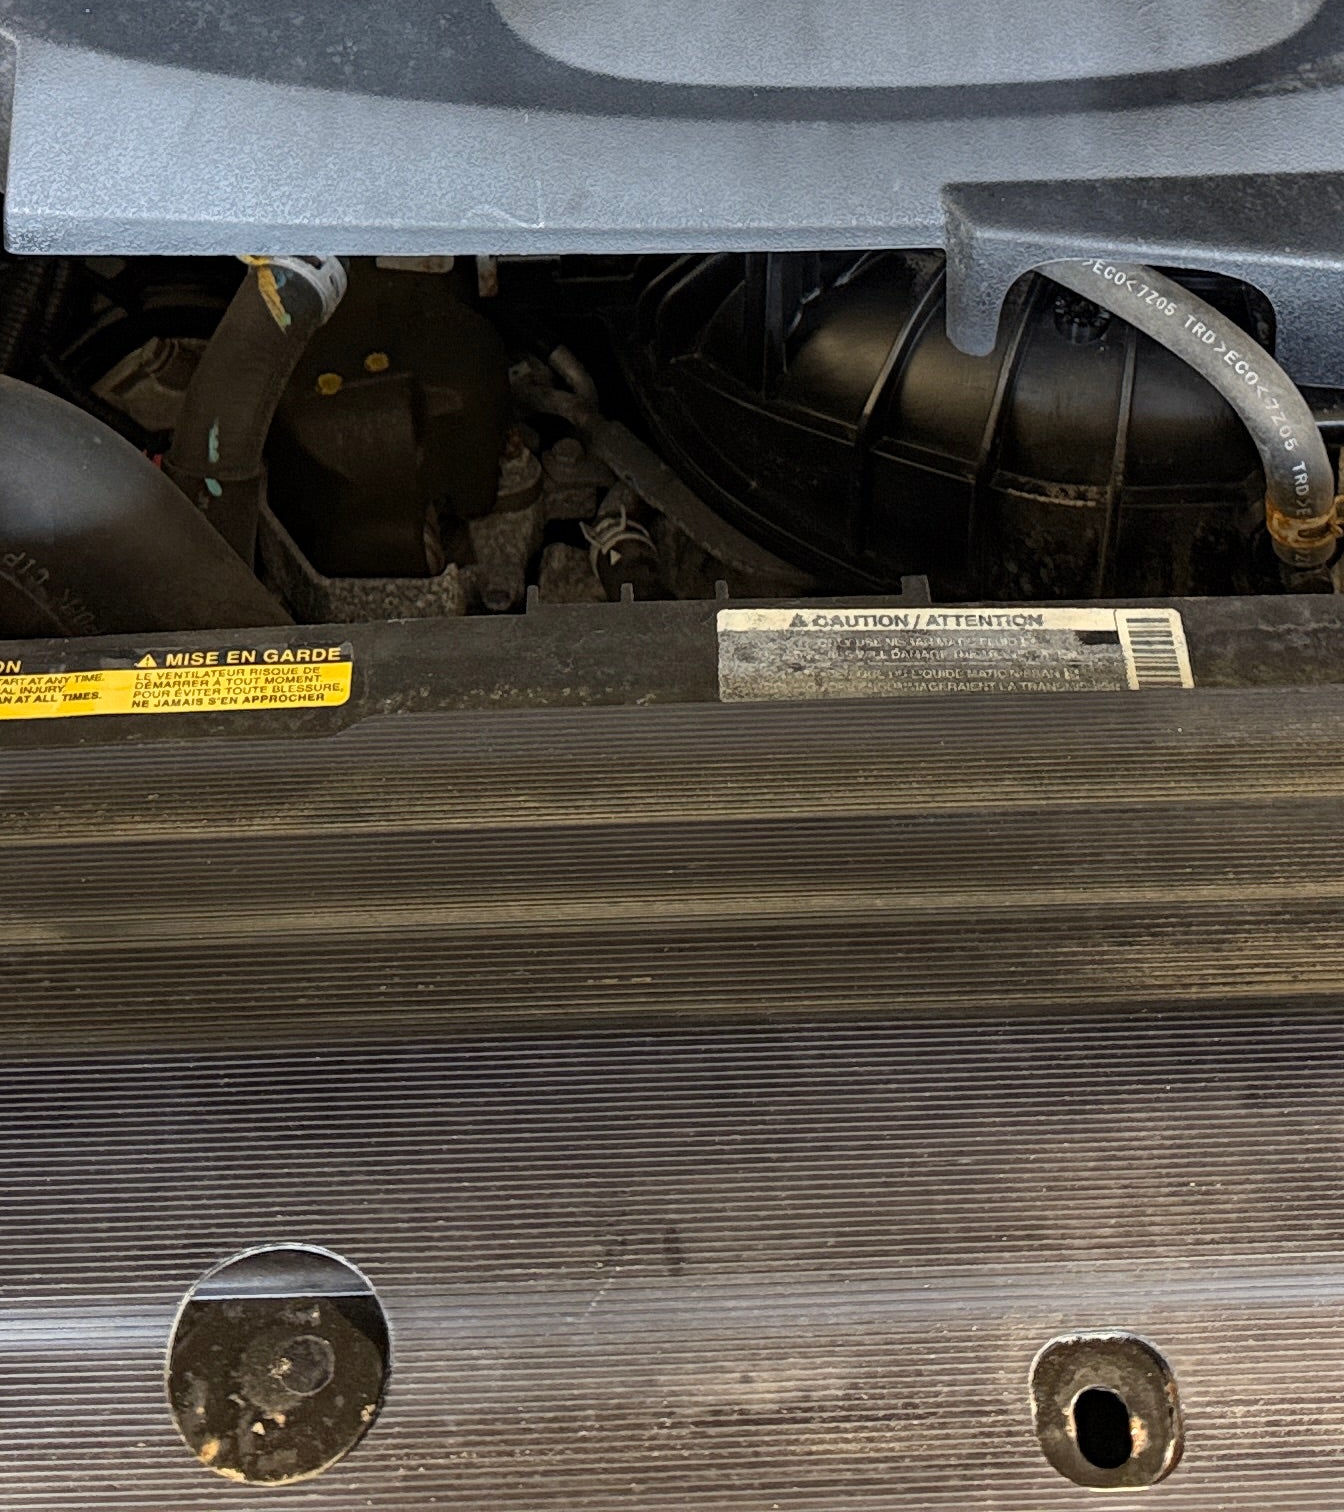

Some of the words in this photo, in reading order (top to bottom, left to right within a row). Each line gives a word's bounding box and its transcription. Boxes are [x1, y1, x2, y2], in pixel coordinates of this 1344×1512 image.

[812, 613, 910, 628] CAUTION
[913, 613, 921, 630] /
[925, 612, 1044, 628] ATTENTION
[165, 651, 220, 667] MISE
[226, 650, 257, 664] EN
[263, 647, 343, 663] GARDE
[136, 672, 153, 681] LE
[156, 668, 246, 680] VENTILATEUR
[249, 666, 300, 677] RISQUE
[303, 665, 321, 675] DE
[27, 676, 43, 686] AT
[45, 675, 72, 685] ANY
[225, 676, 262, 686] TOUT
[15, 694, 33, 704] AT
[33, 693, 58, 703] ALL
[132, 689, 170, 699] POUR
[225, 686, 268, 695] TOUTE
[131, 699, 149, 709] NE
[153, 697, 204, 708] JAMAIS
[207, 696, 239, 706] S'EN
[242, 692, 326, 704] APPROCHER
